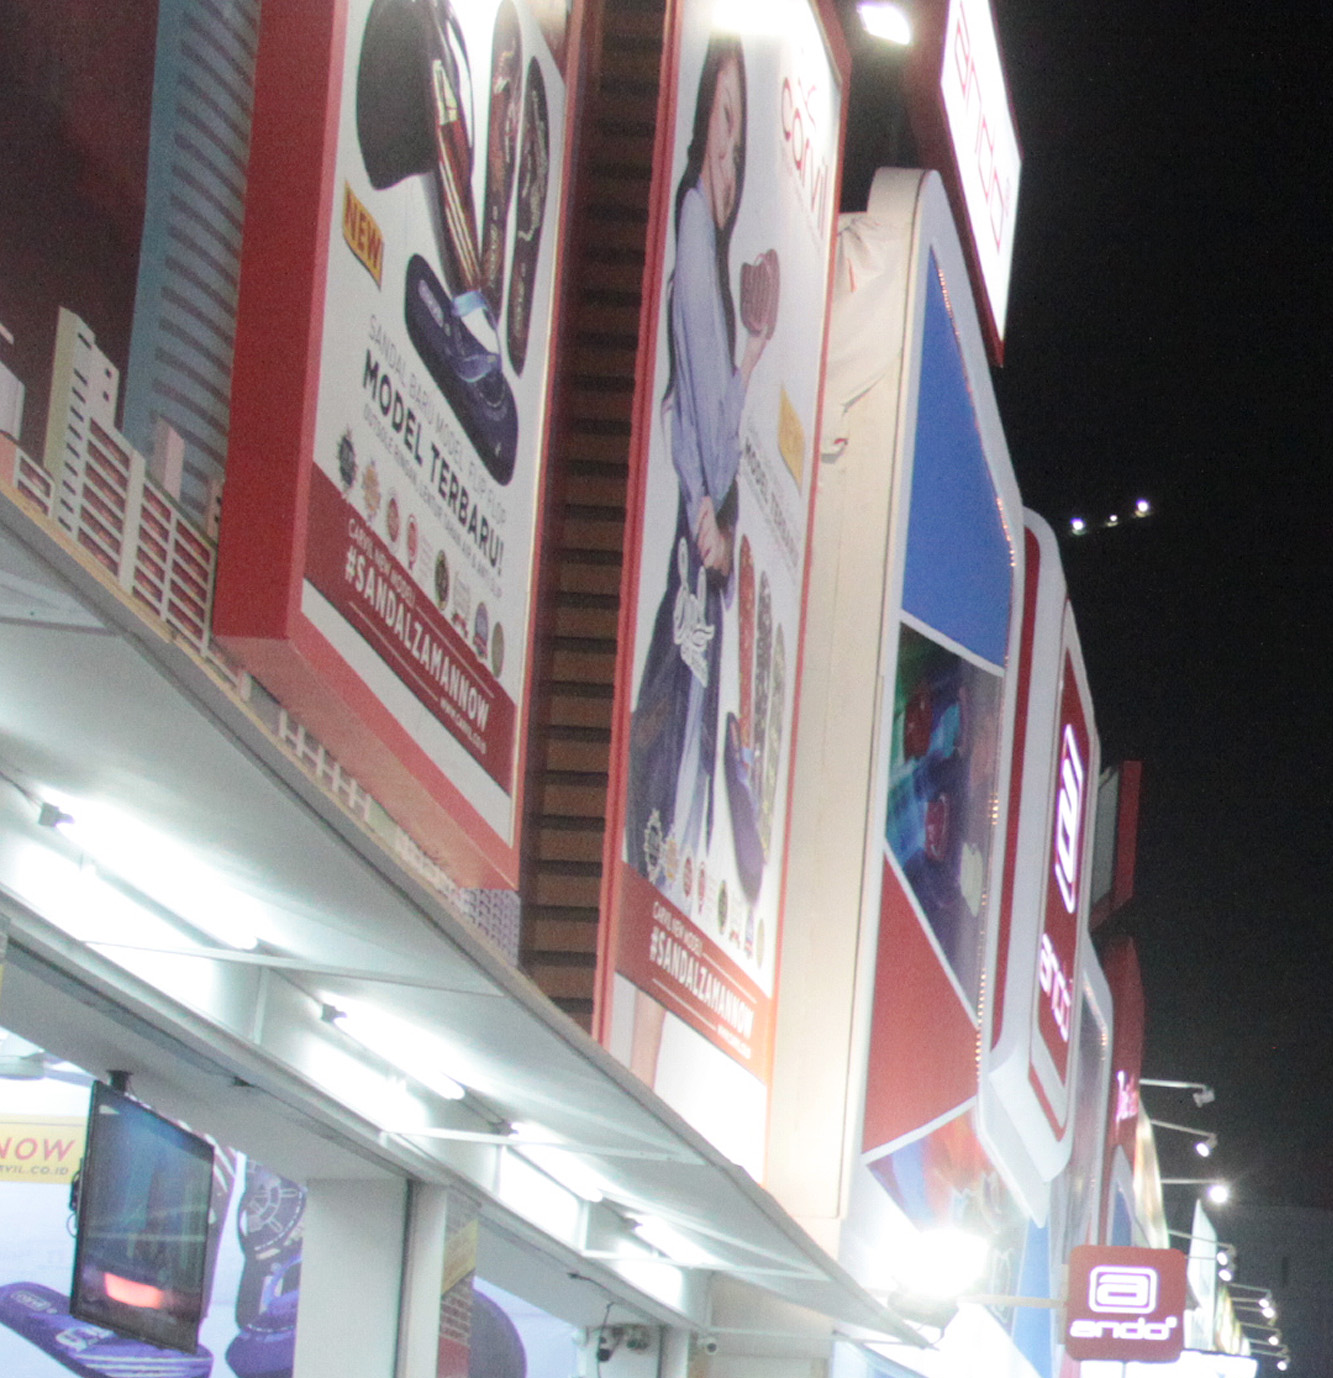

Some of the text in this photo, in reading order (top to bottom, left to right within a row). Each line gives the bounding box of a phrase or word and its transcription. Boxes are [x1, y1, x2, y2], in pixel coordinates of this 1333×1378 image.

[344, 187, 383, 273] NEW
[363, 349, 505, 578] MODEL TERBARU!
[344, 545, 491, 732] #SANDALZAMANNOW
